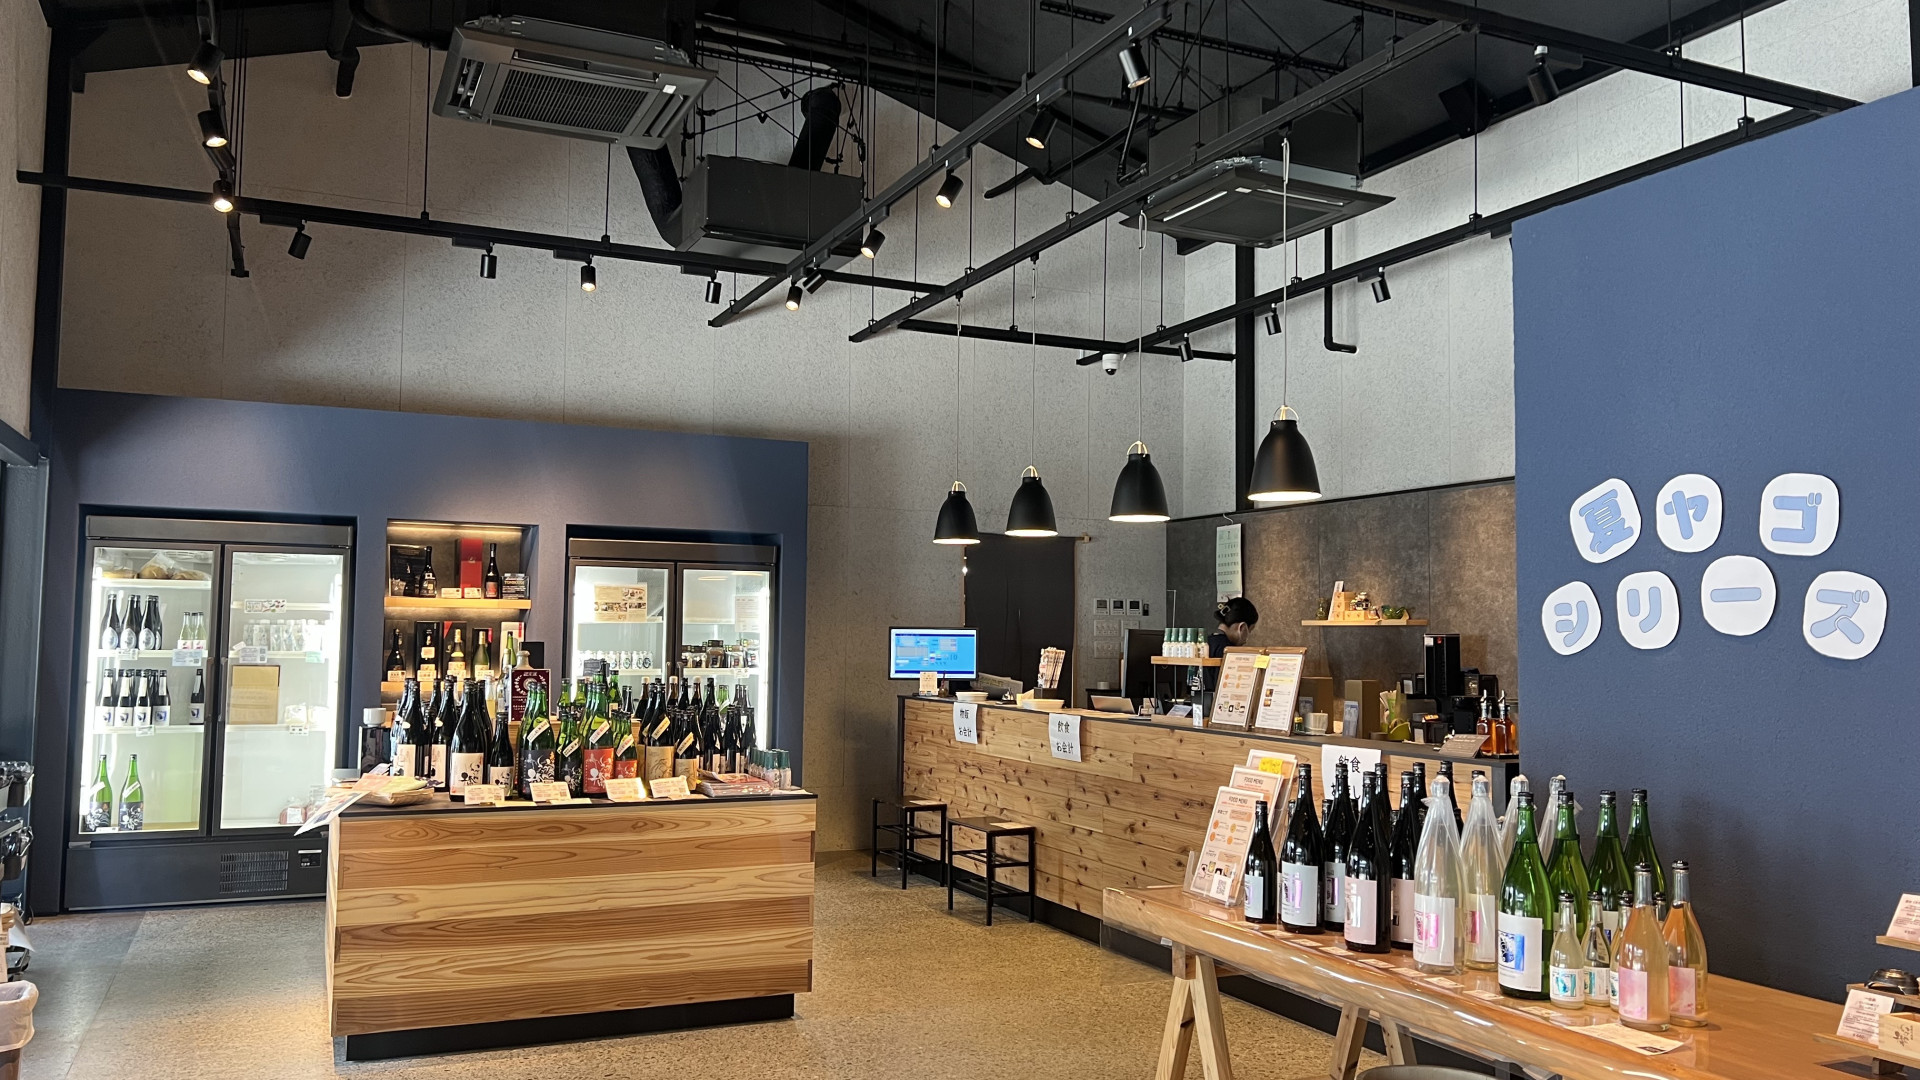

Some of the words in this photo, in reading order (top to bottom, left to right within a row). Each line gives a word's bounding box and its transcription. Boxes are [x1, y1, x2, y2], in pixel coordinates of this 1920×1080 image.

[1578, 488, 1823, 555] 夏ヤゴ
[1553, 586, 1870, 648] シリーズ
[1057, 720, 1070, 733] 飲食
[1056, 742, 1074, 755] お会計
